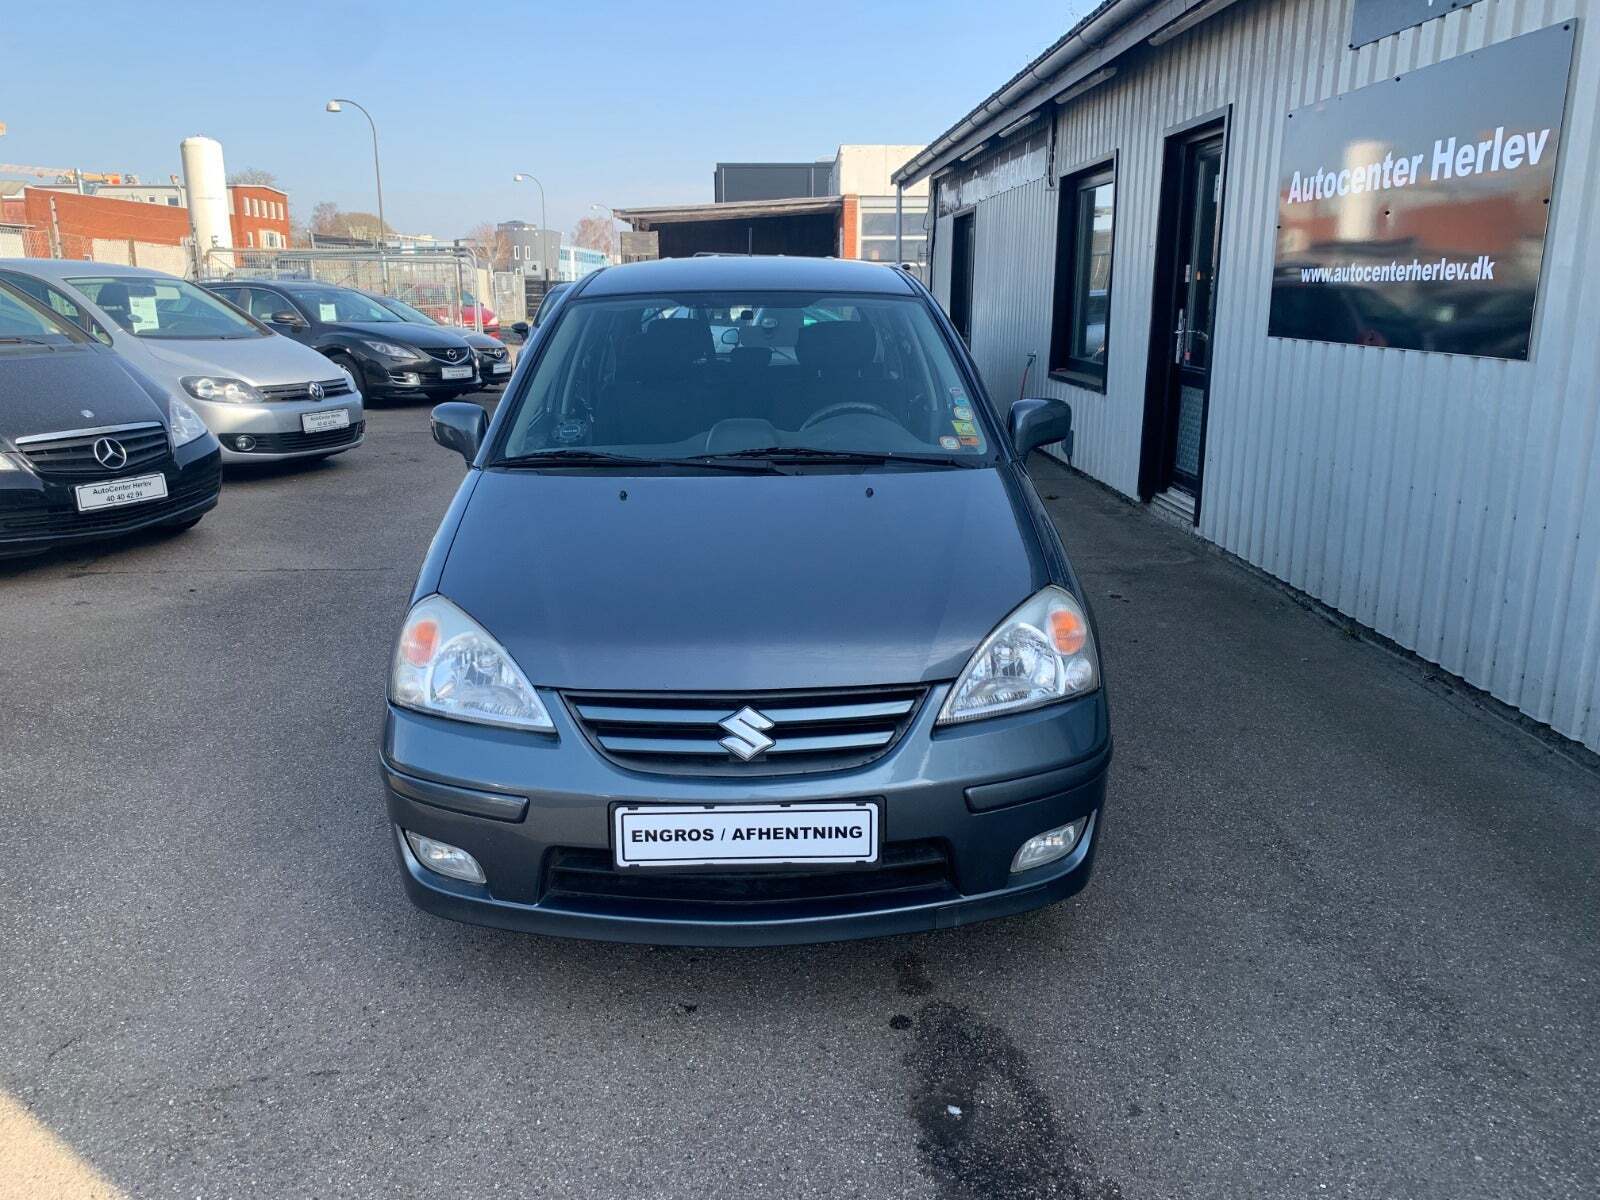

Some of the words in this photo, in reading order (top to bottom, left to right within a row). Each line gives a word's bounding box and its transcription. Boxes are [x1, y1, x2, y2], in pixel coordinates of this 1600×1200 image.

[1287, 150, 1424, 205] Autocenter
[1431, 126, 1550, 182] Herlev
[1300, 255, 1496, 284] www.autocenterherlev.dk
[93, 484, 131, 495] AutoCenter
[117, 493, 126, 501] 40
[631, 828, 715, 843] ENGROS
[720, 828, 727, 841] /
[731, 825, 863, 841] AFHENTNING
